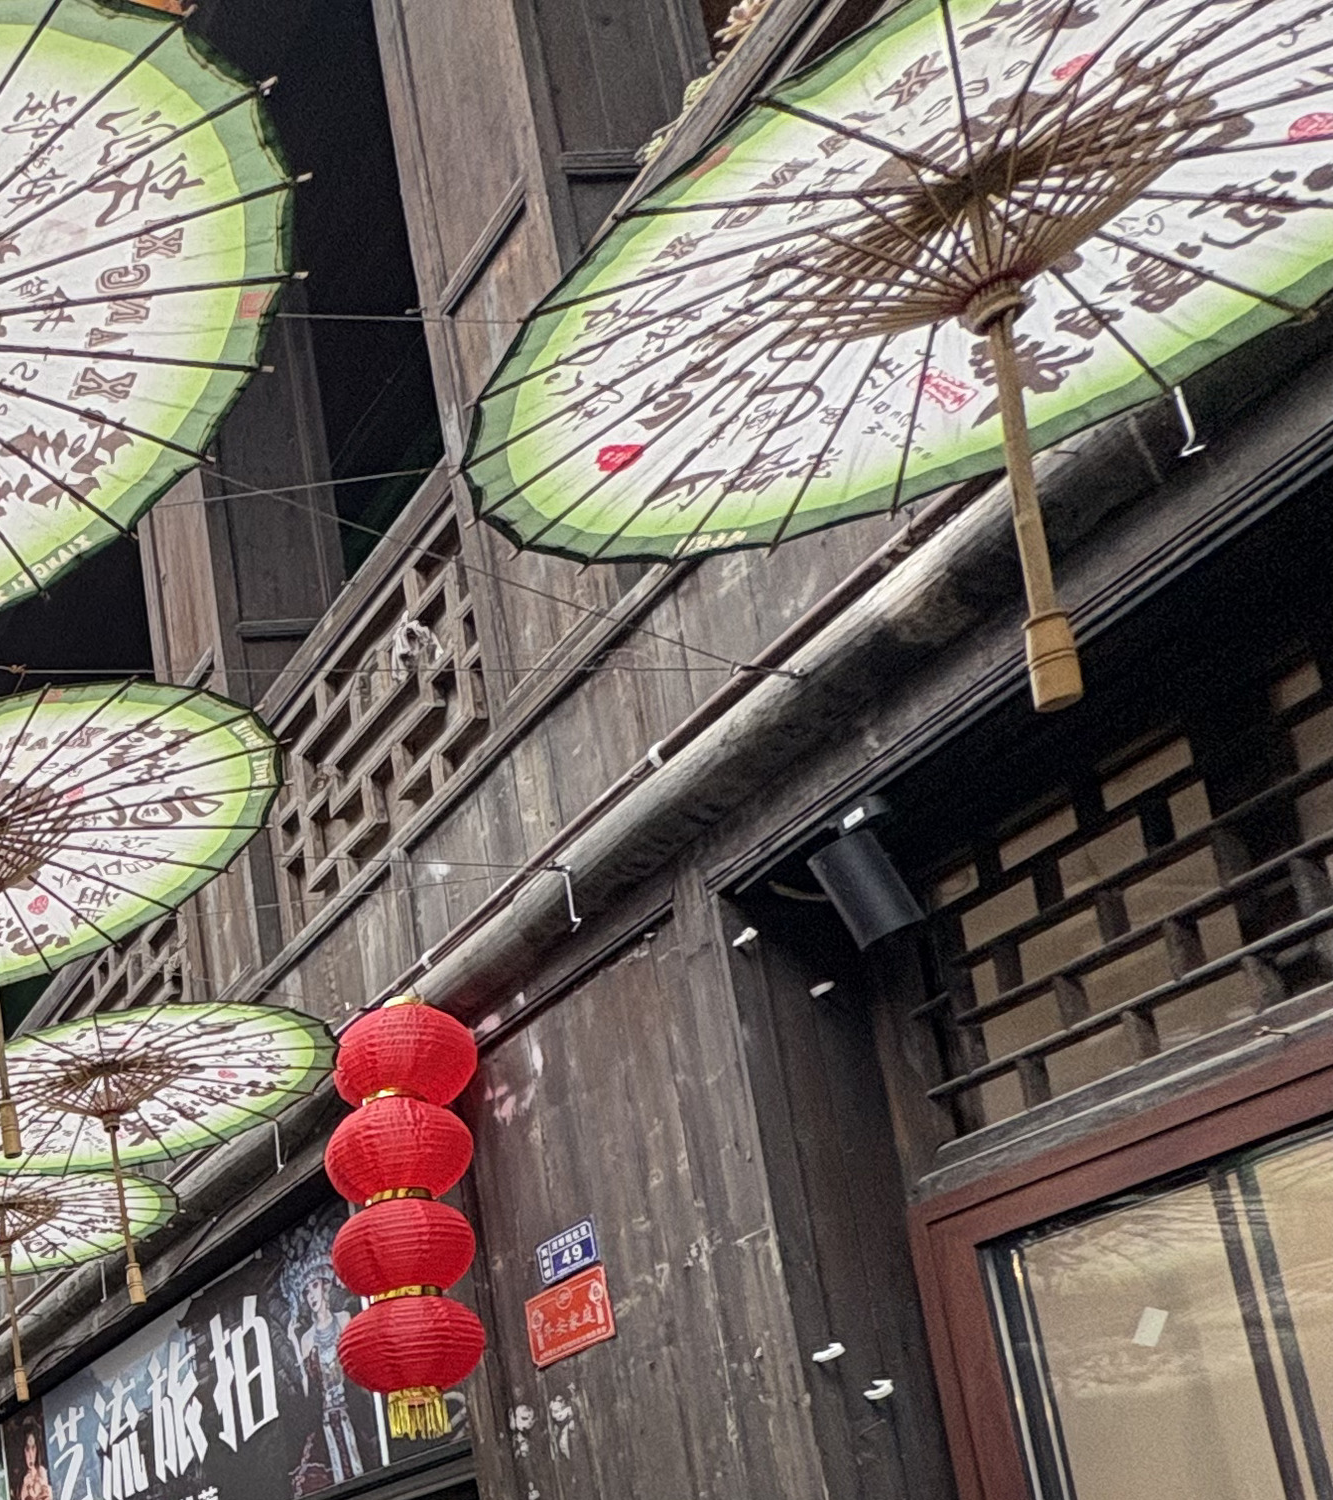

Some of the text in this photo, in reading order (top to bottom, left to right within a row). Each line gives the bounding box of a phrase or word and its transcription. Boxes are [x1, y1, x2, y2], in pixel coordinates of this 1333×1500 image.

[561, 1243, 583, 1265] 49
[543, 1303, 596, 1341] 平安家庭
